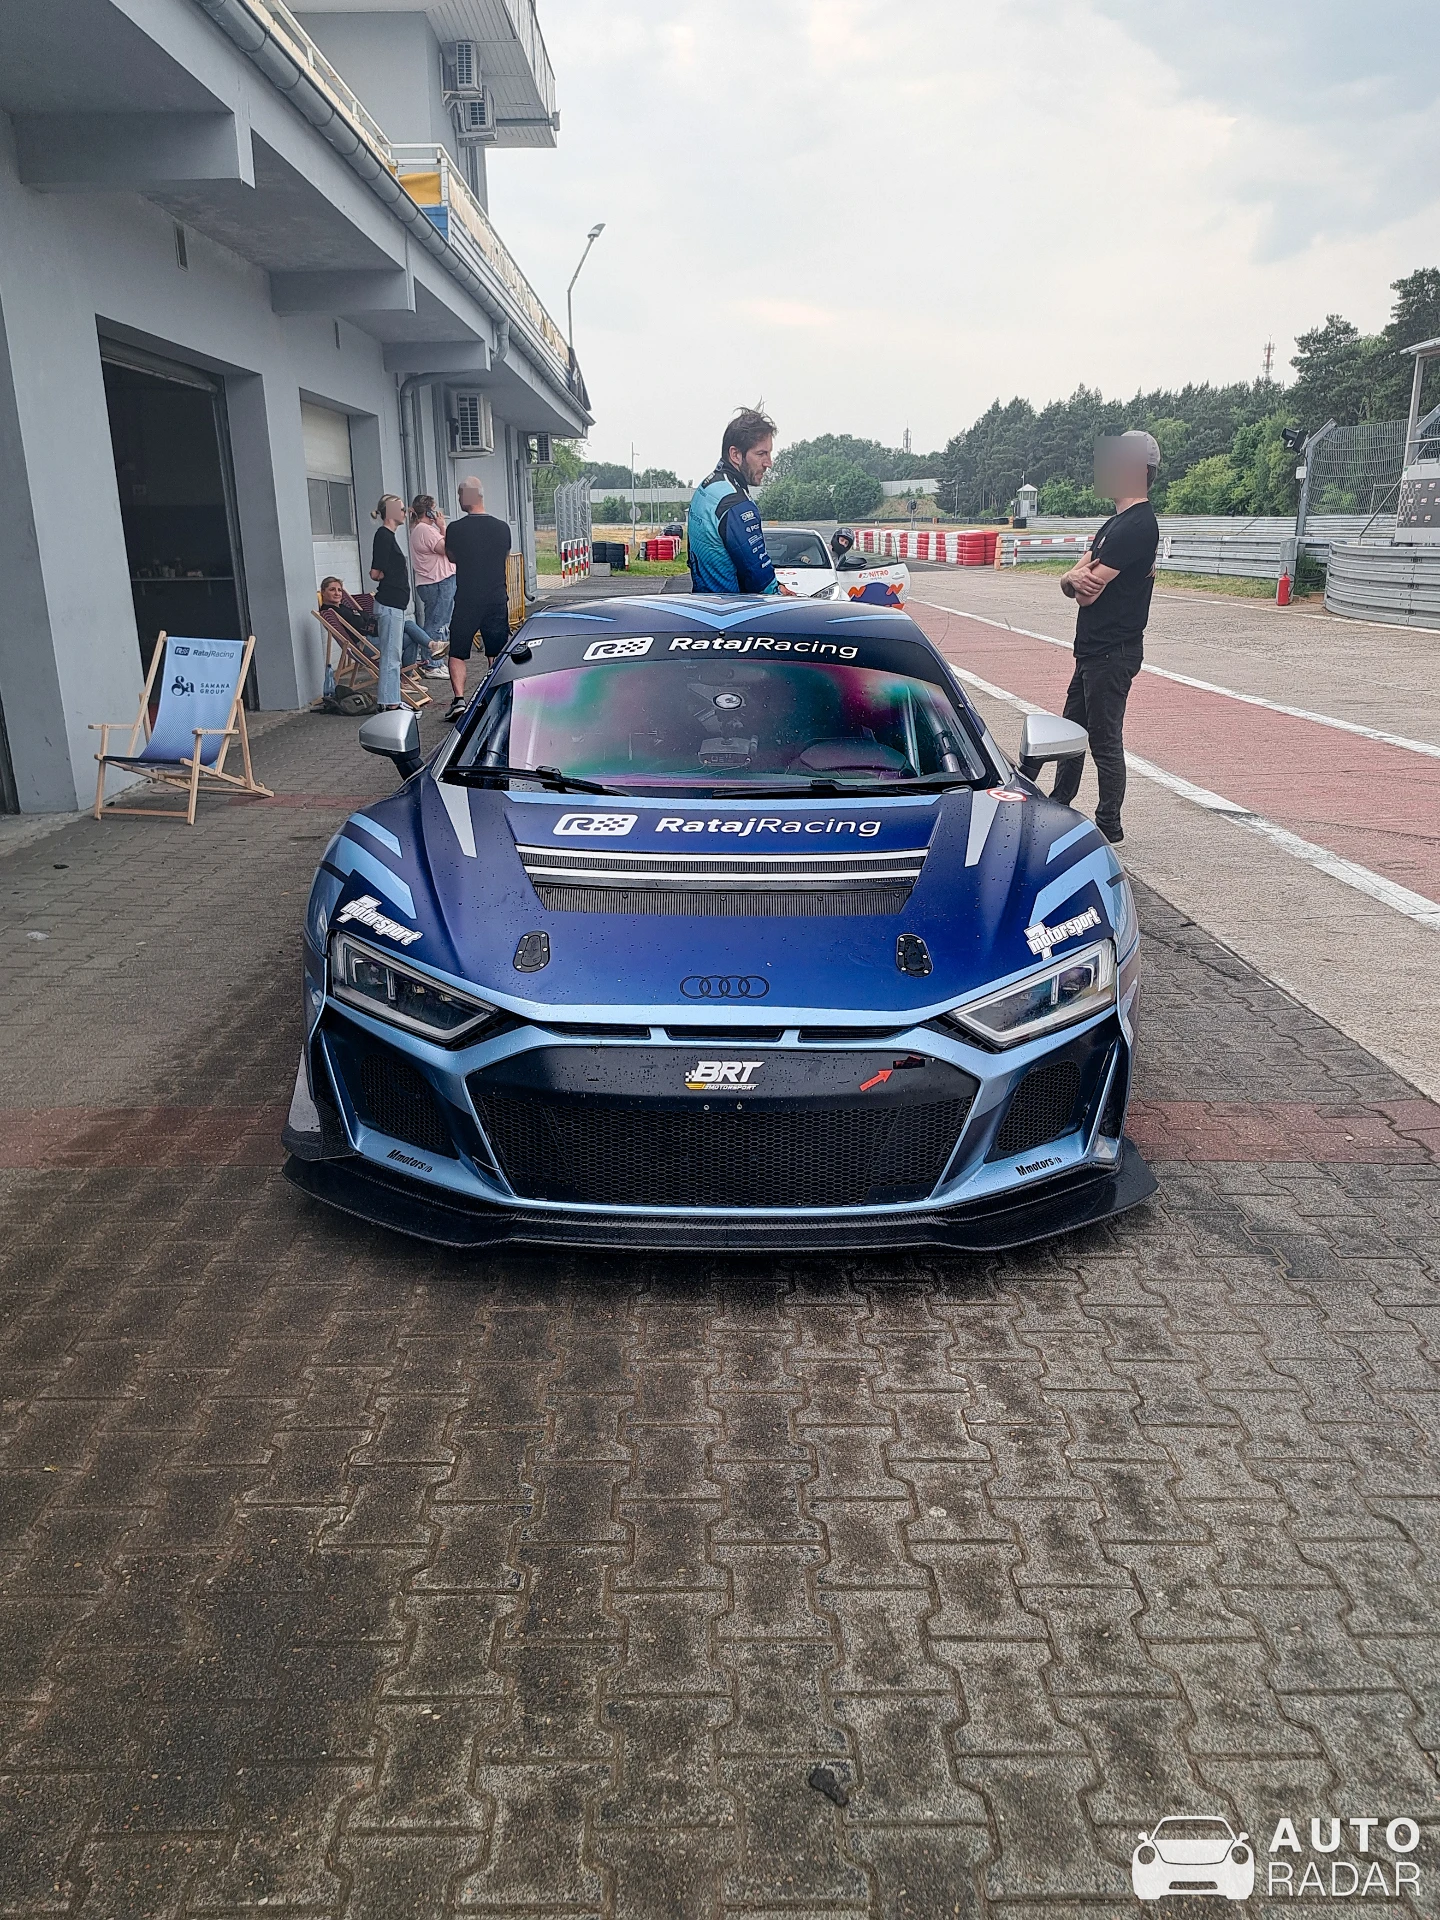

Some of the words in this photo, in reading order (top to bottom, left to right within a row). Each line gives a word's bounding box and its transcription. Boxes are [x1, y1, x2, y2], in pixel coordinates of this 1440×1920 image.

[868, 569, 889, 578] NITRO
[193, 649, 235, 659] RatajRacing
[668, 637, 859, 659] RatajRacing
[655, 817, 881, 837] RatajRacing
[1026, 906, 1102, 955] motorsport
[691, 1061, 765, 1083] BRT
